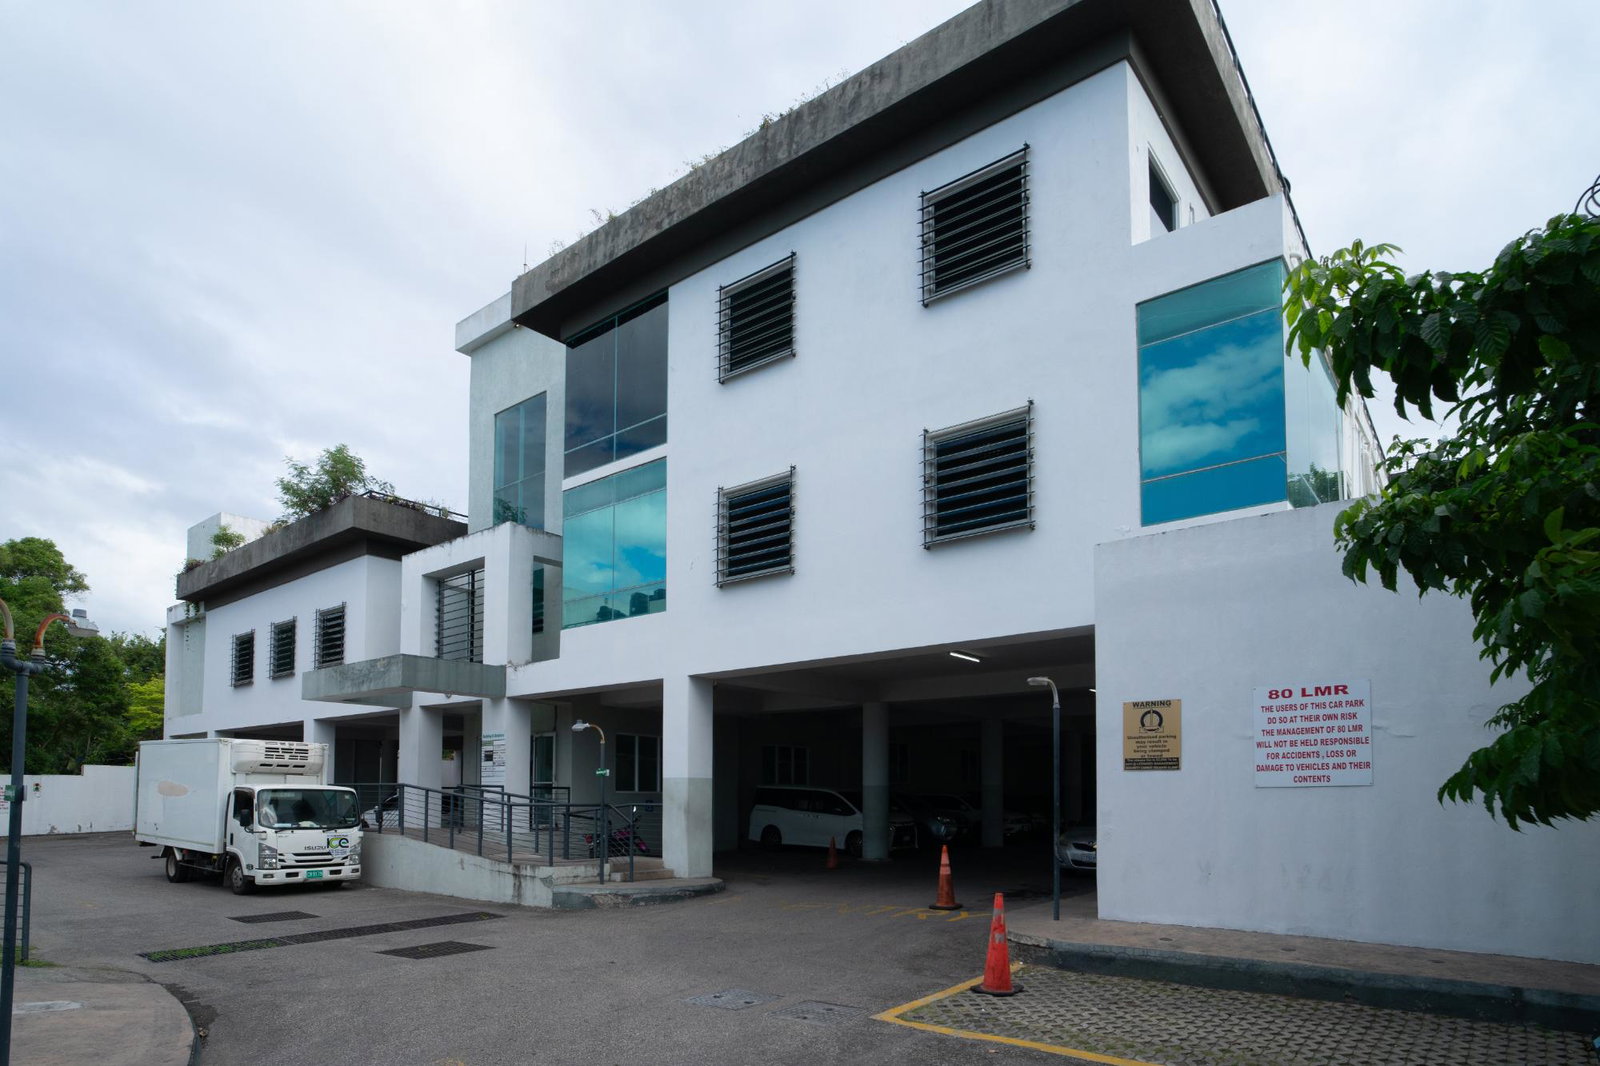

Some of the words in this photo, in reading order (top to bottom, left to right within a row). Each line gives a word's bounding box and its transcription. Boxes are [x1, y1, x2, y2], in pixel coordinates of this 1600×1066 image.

[1268, 689, 1293, 699] 80
[1301, 684, 1349, 697] LMR
[1132, 700, 1172, 708] WARNING
[1261, 705, 1274, 713] THE
[1276, 704, 1298, 712] USERS
[1300, 703, 1309, 711] OF
[1310, 701, 1327, 710] THIS
[1328, 700, 1343, 709] CAR
[1345, 699, 1365, 707] PARK
[1279, 716, 1288, 724] SO
[1289, 715, 1298, 723] AT
[1300, 714, 1321, 722] THEIR
[1322, 713, 1338, 721] OWN
[1340, 712, 1358, 720] RISK
[1261, 729, 1274, 737] THE
[1276, 726, 1324, 736] MANAGEMENT
[1337, 725, 1346, 733] 80
[1347, 724, 1363, 732] LMR
[1256, 740, 1272, 748] WILL
[1273, 740, 1287, 748] NOT
[1300, 738, 1319, 746] HELD
[1320, 736, 1370, 746] RESPONSIBLE
[1266, 752, 1280, 760] FOR
[1281, 751, 1320, 760] ACCIDENTS
[1326, 750, 1344, 758] LOSS
[1346, 749, 1357, 757] OR
[1256, 764, 1284, 772] DAMAGE
[1296, 763, 1330, 771] VEHICLES
[1331, 762, 1347, 770] AND
[1348, 761, 1371, 769] THEIR
[1293, 775, 1331, 783] CONTENTS
